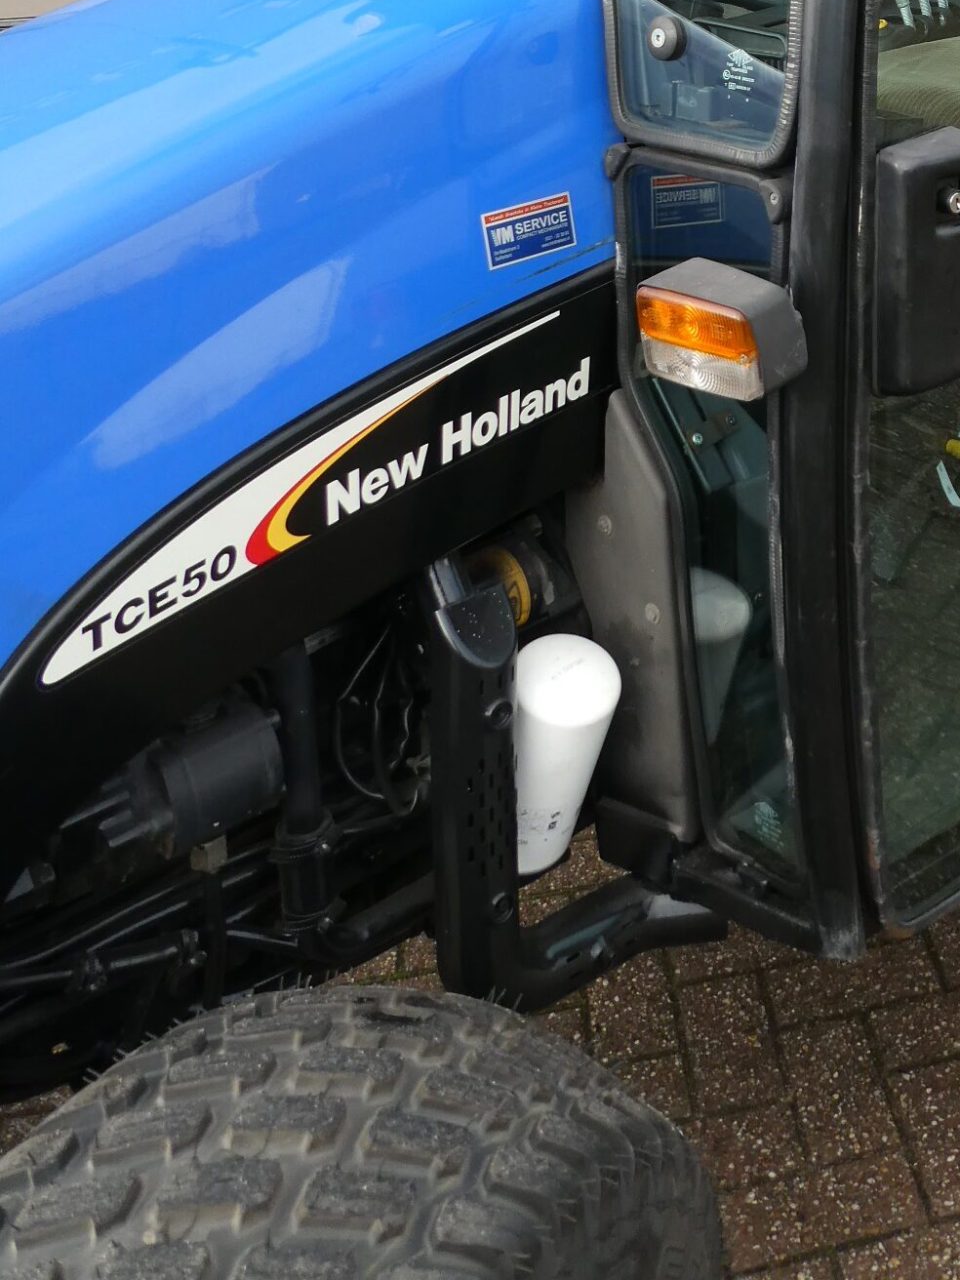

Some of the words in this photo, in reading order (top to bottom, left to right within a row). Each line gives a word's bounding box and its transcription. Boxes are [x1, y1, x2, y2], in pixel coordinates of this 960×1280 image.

[515, 210, 569, 235] SERVICE
[326, 443, 429, 526] New
[441, 356, 591, 465] Holland
[82, 545, 237, 651] TCE50
